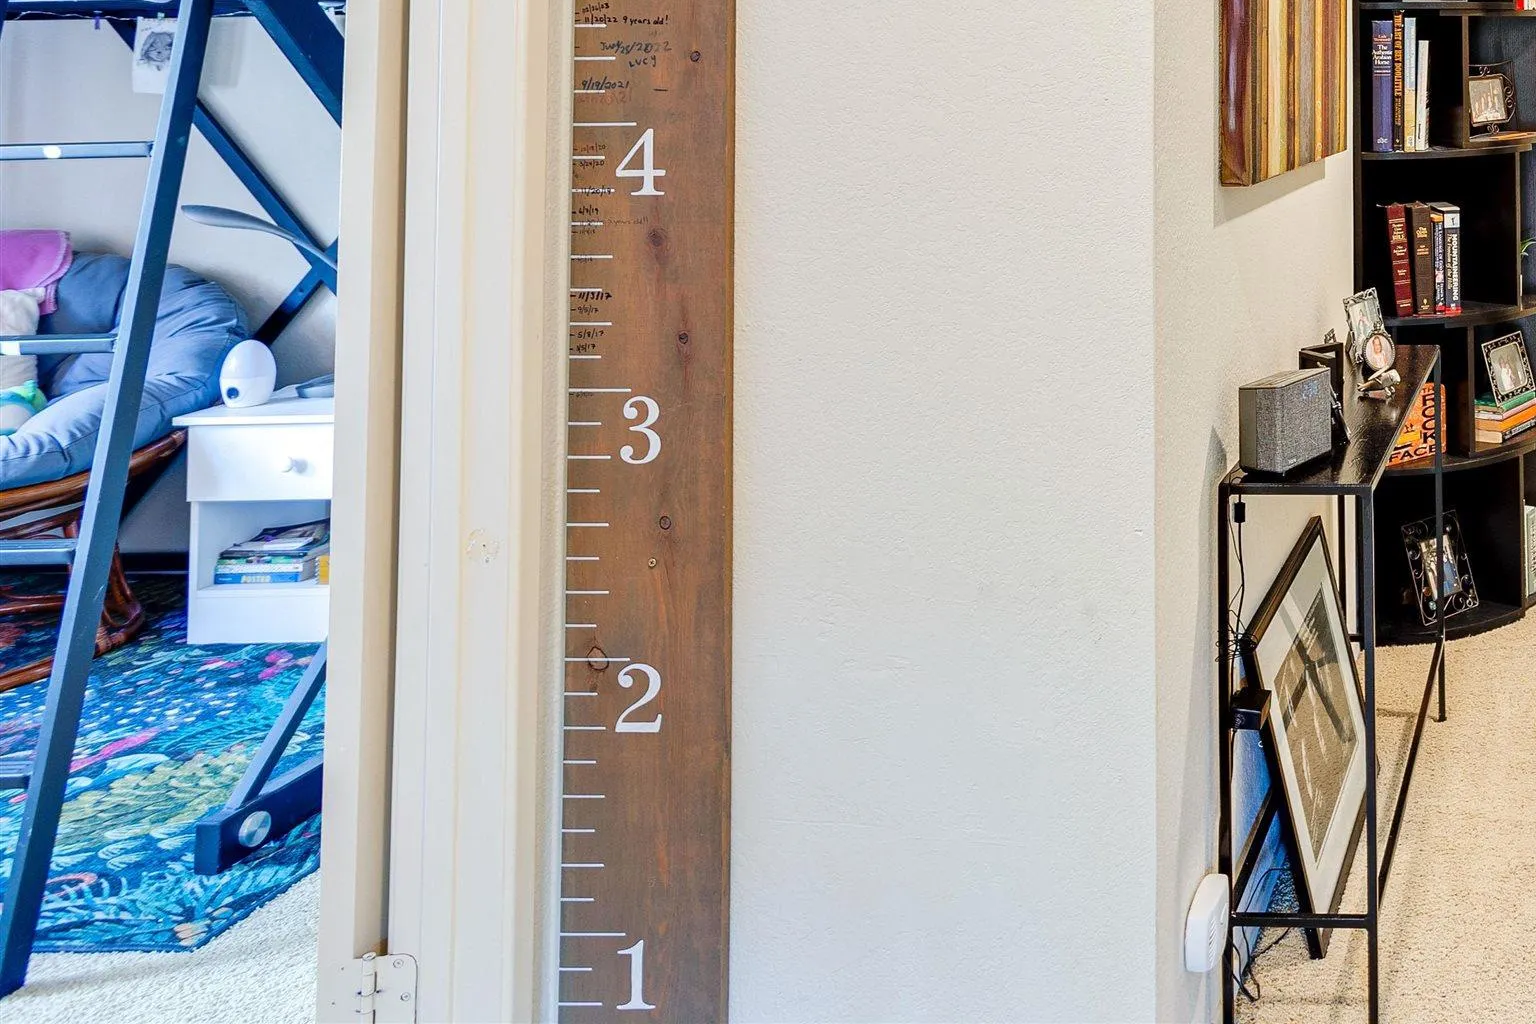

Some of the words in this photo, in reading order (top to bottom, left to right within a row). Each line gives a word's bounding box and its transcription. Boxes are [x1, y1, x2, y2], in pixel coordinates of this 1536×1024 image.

[615, 128, 667, 196] 4
[620, 396, 662, 464] 3
[1389, 445, 1436, 462] FACE
[614, 663, 663, 733] 2
[616, 939, 656, 1011] 1
